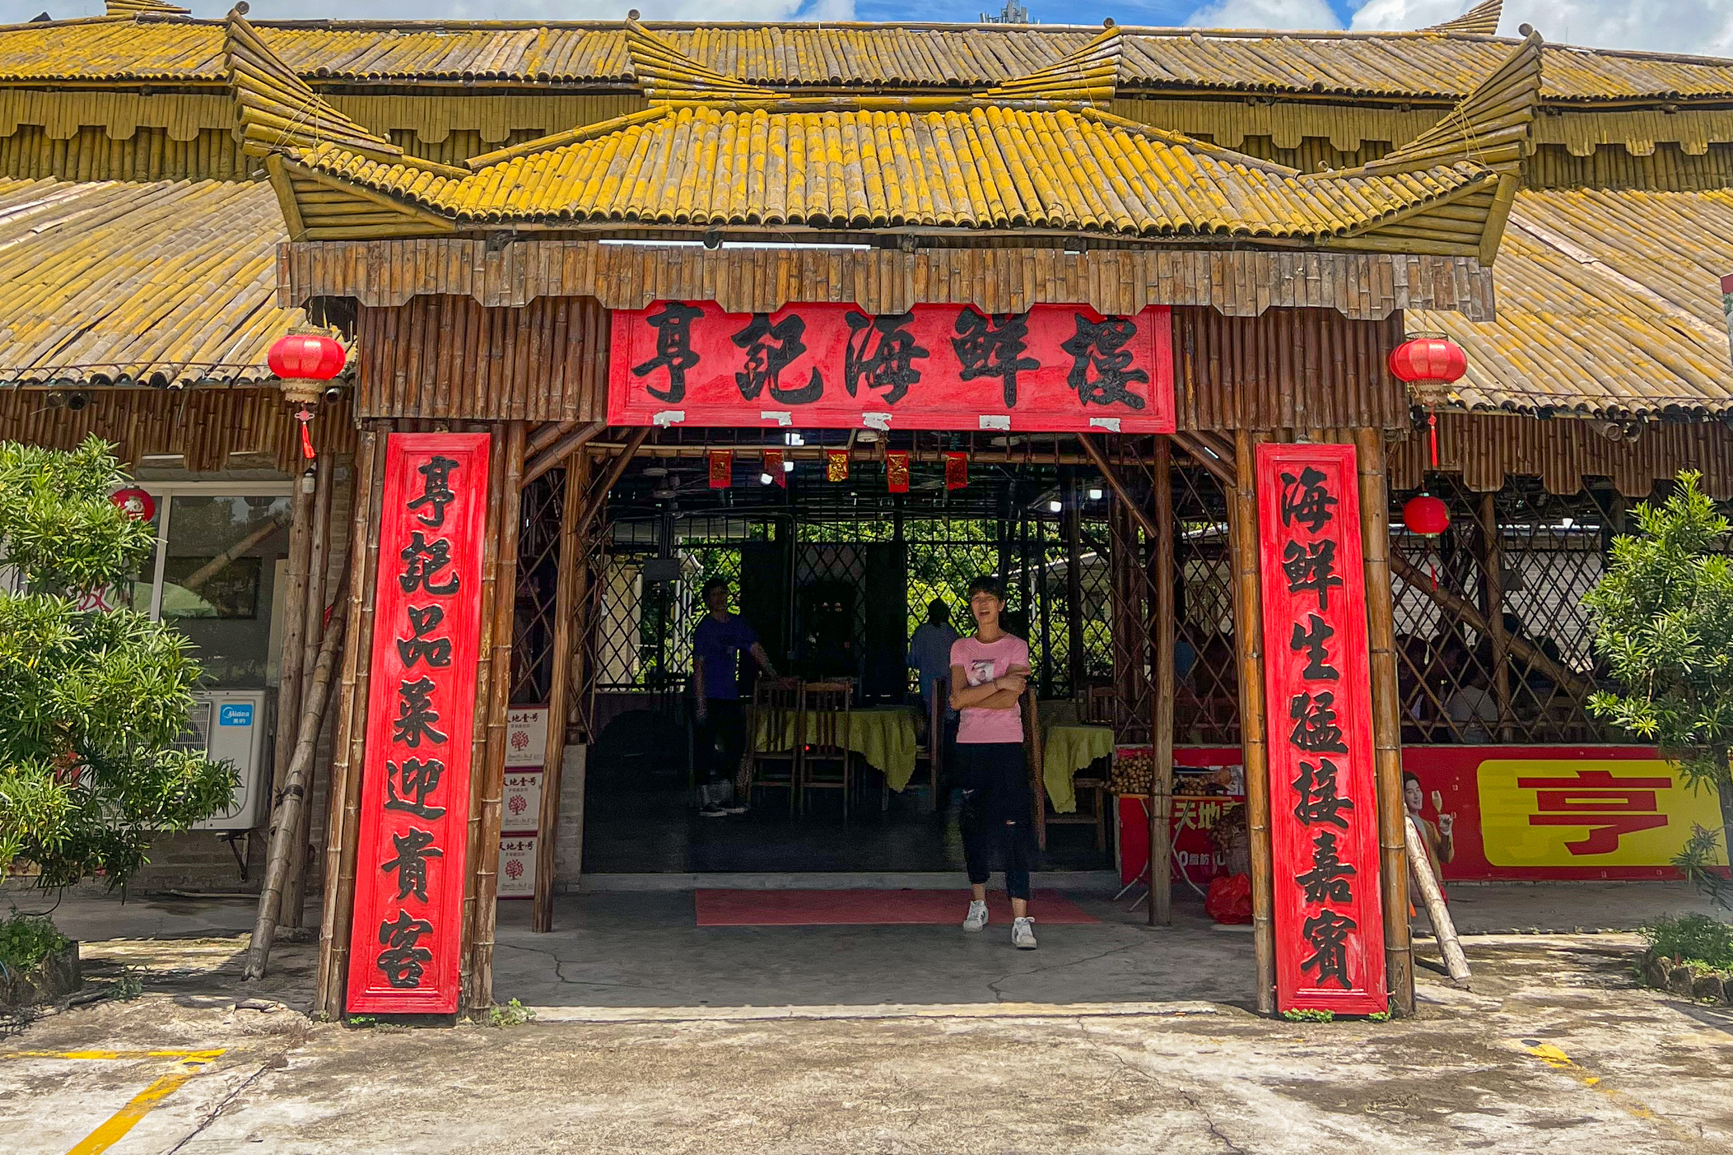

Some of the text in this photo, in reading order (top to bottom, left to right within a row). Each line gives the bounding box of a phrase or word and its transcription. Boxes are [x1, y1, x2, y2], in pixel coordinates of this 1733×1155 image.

[227, 710, 250, 718] Midea
[507, 712, 539, 723] 地壹号
